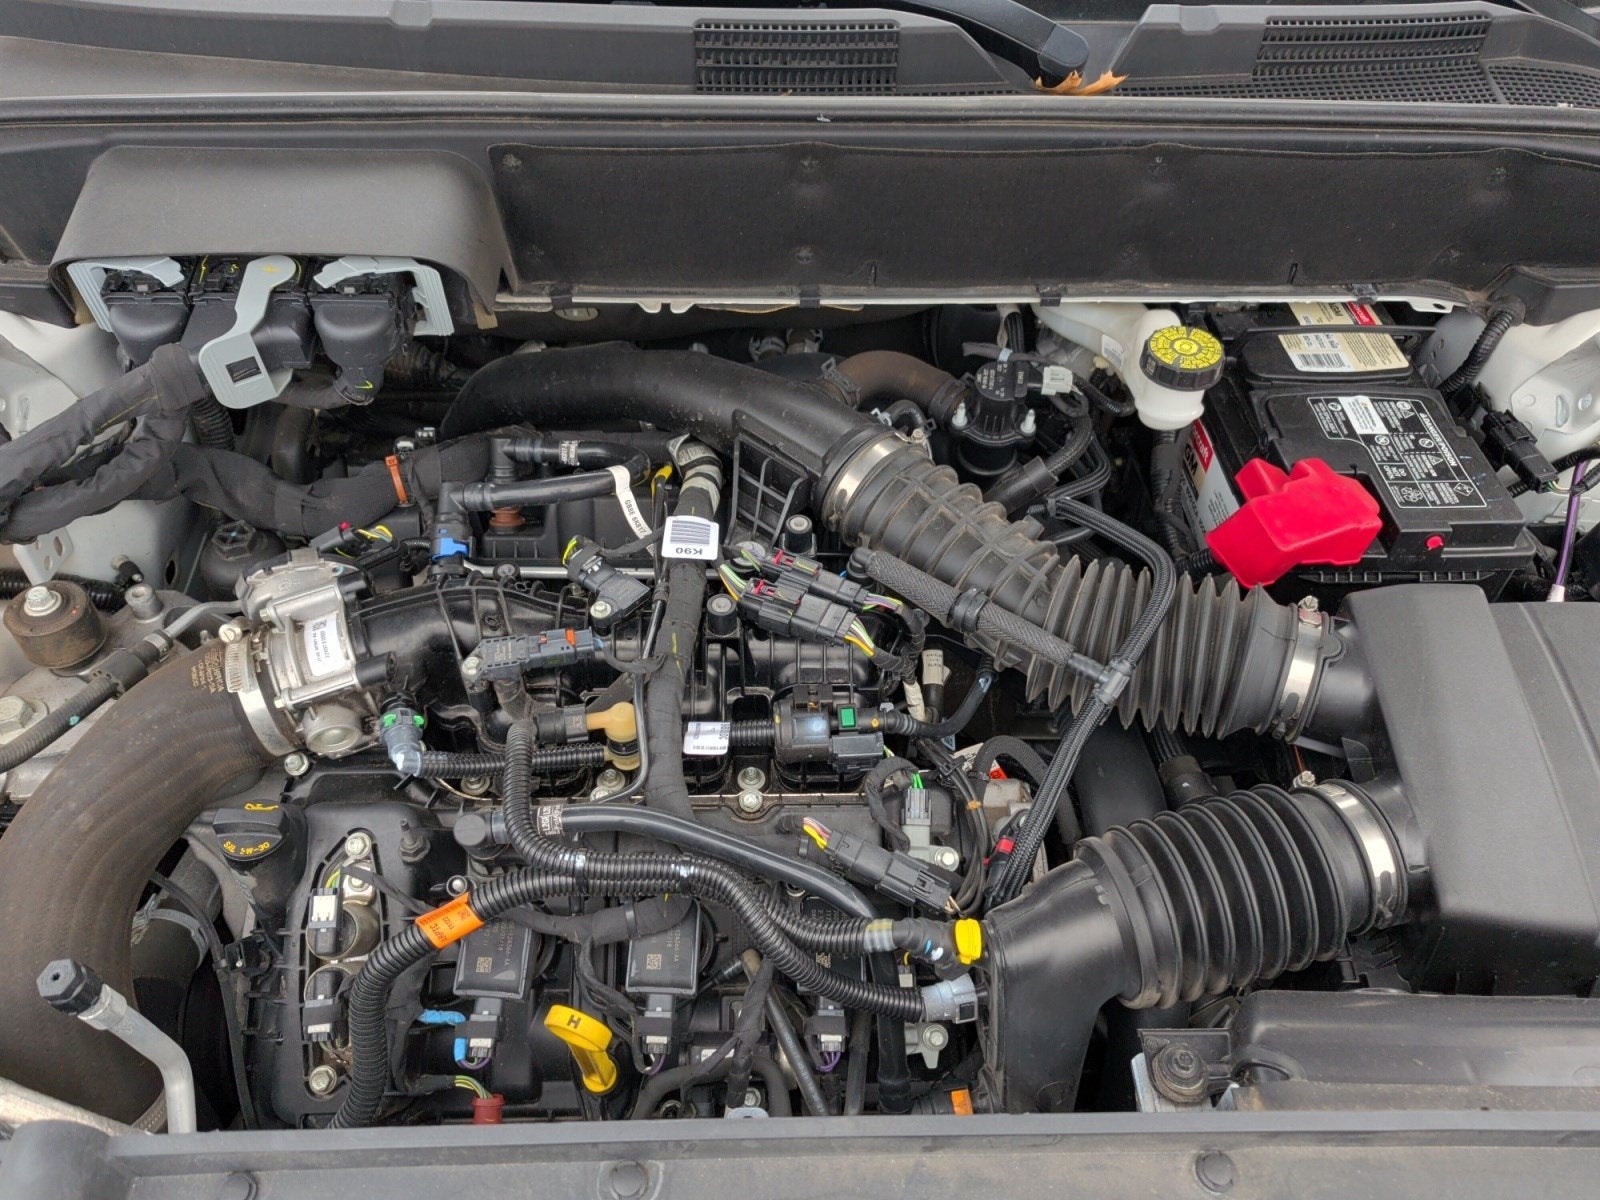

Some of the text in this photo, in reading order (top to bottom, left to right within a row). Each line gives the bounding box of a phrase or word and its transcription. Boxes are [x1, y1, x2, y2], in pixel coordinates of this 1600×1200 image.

[1423, 417, 1442, 442] DANGER
[1439, 442, 1458, 467] POISON
[675, 547, 703, 556] K90
[239, 841, 270, 855] 5W-30
[566, 1014, 582, 1029] H
